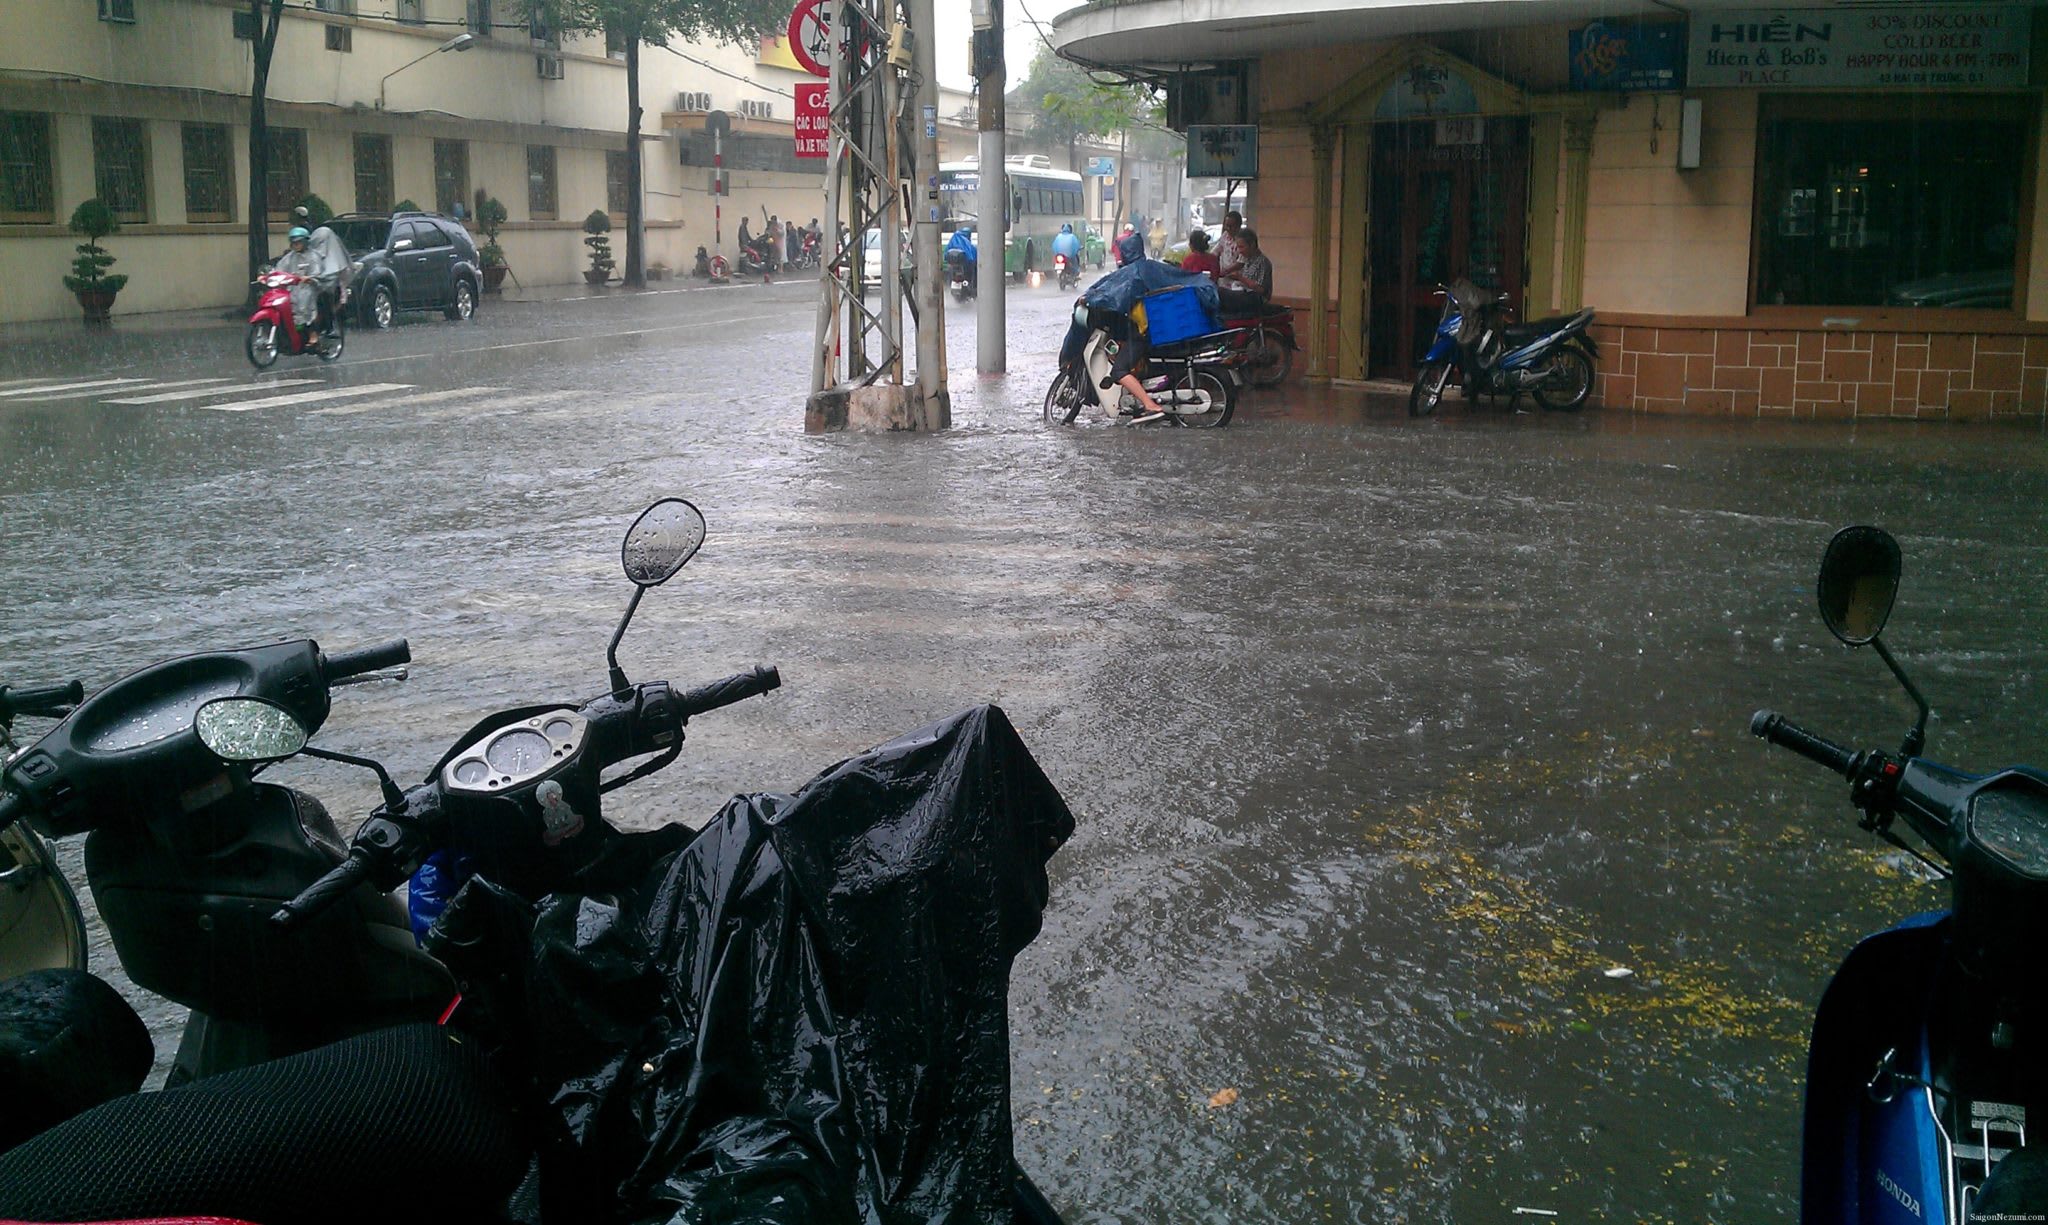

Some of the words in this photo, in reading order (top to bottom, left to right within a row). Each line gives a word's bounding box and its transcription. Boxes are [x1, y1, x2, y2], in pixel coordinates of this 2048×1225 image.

[1912, 15, 2001, 30] DISCOUNT
[1883, 33, 1934, 50] COLD
[1938, 33, 1983, 49] BEER
[1755, 48, 1774, 66] &
[1846, 54, 1895, 68] HAPPY
[1897, 54, 1938, 68] HOUR
[1953, 53, 1978, 67] PM
[1738, 69, 1793, 84] PLACE
[796, 113, 811, 130] CÁC
[795, 135, 806, 153] VÀ
[806, 138, 816, 153] XE
[1877, 1169, 1921, 1218] HONDA
